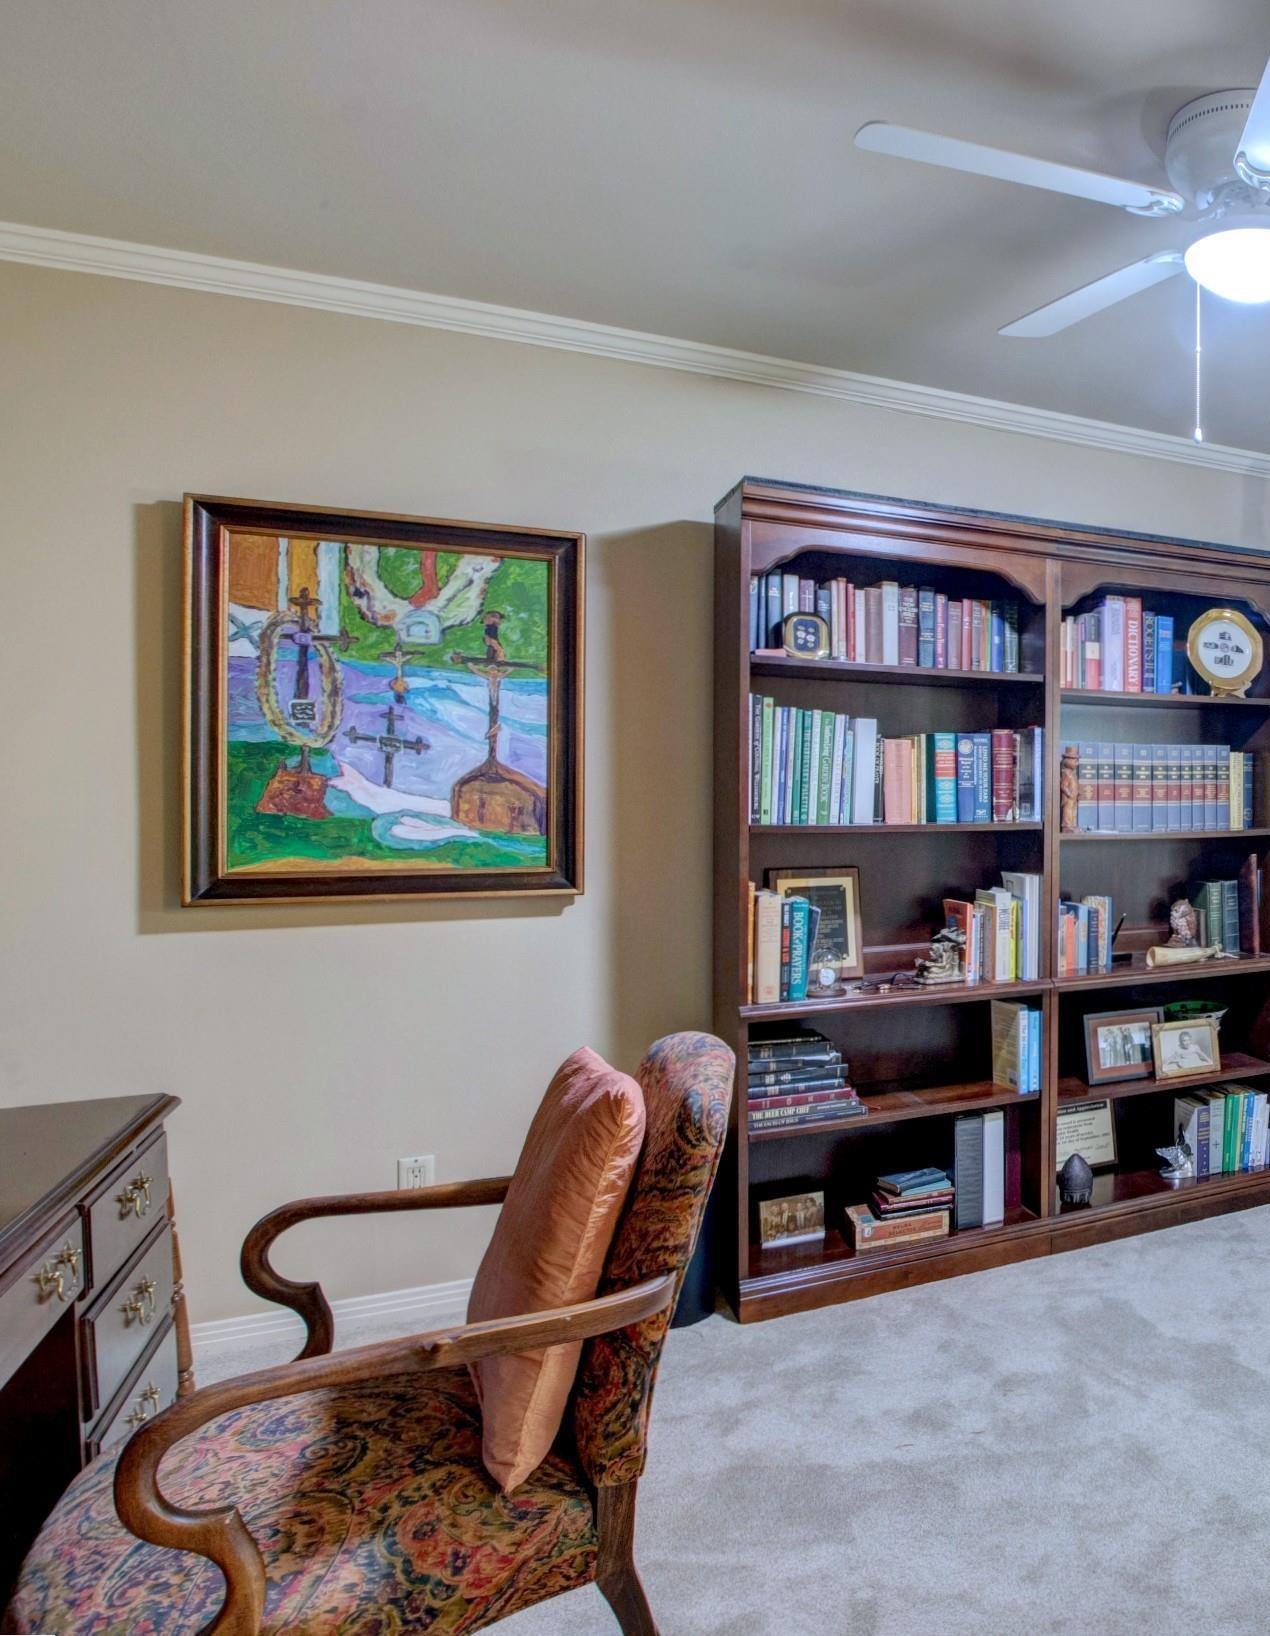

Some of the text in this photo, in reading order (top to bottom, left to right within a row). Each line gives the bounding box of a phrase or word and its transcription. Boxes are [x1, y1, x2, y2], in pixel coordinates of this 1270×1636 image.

[1127, 620, 1139, 685] DICTIONARY
[793, 911, 804, 939] BOOK
[791, 944, 802, 985] PRAYERS
[751, 1111, 765, 1121] THE
